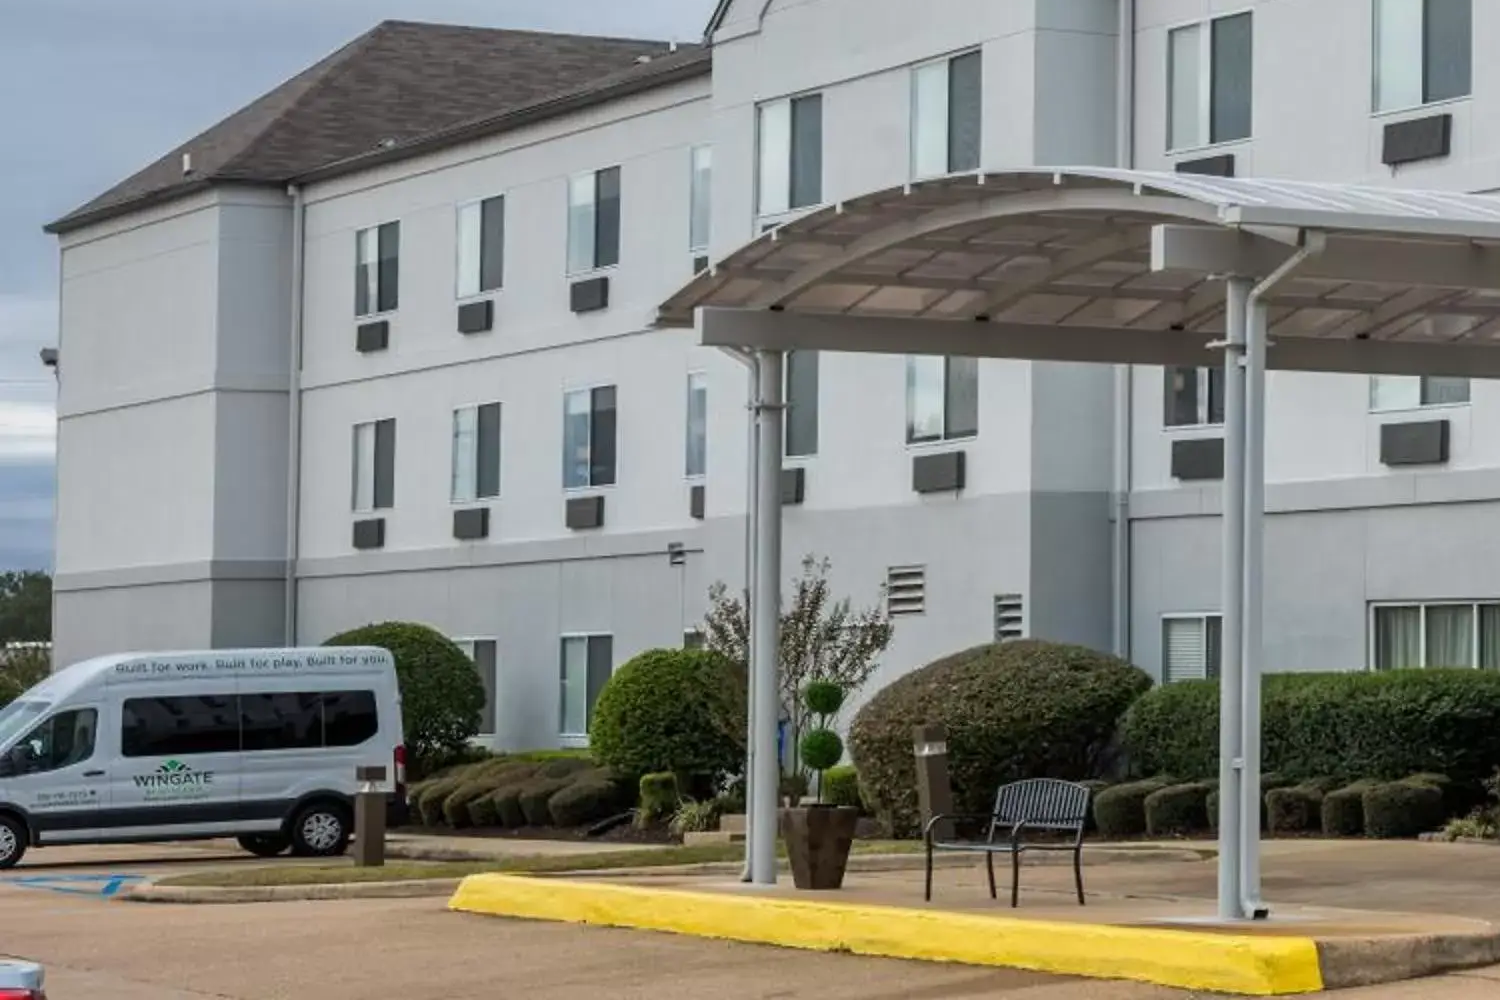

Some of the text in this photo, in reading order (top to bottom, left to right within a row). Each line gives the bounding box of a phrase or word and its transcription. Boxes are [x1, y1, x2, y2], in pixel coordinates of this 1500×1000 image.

[151, 662, 170, 672] for
[340, 655, 358, 665] for
[133, 770, 214, 787] WINGATE
